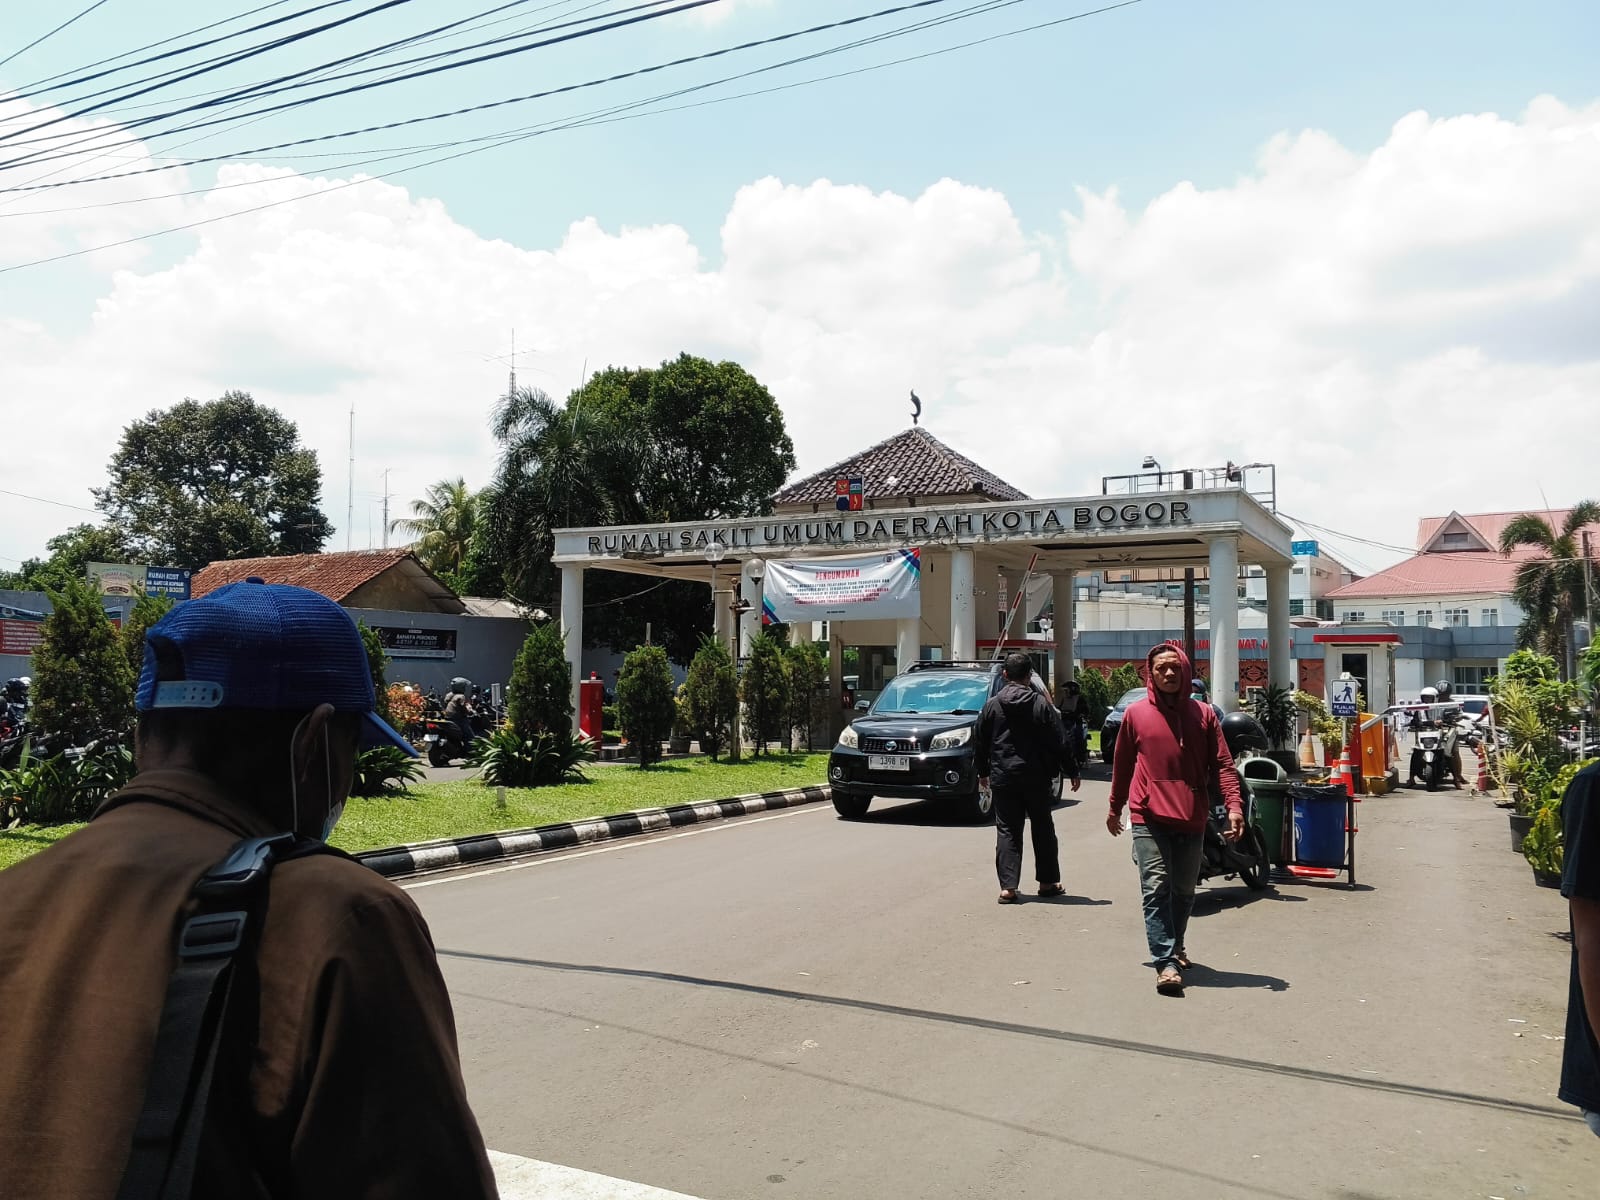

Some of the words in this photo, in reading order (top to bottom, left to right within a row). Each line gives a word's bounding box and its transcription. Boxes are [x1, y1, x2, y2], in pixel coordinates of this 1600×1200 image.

[588, 530, 672, 551] RUMAH
[680, 527, 753, 546] SAKIT
[763, 521, 842, 541] UMUM
[853, 513, 973, 537] DAERAH
[982, 509, 1064, 530] KOTA
[1073, 502, 1190, 526] BOGOR
[815, 569, 860, 581] PENGUMUMAN
